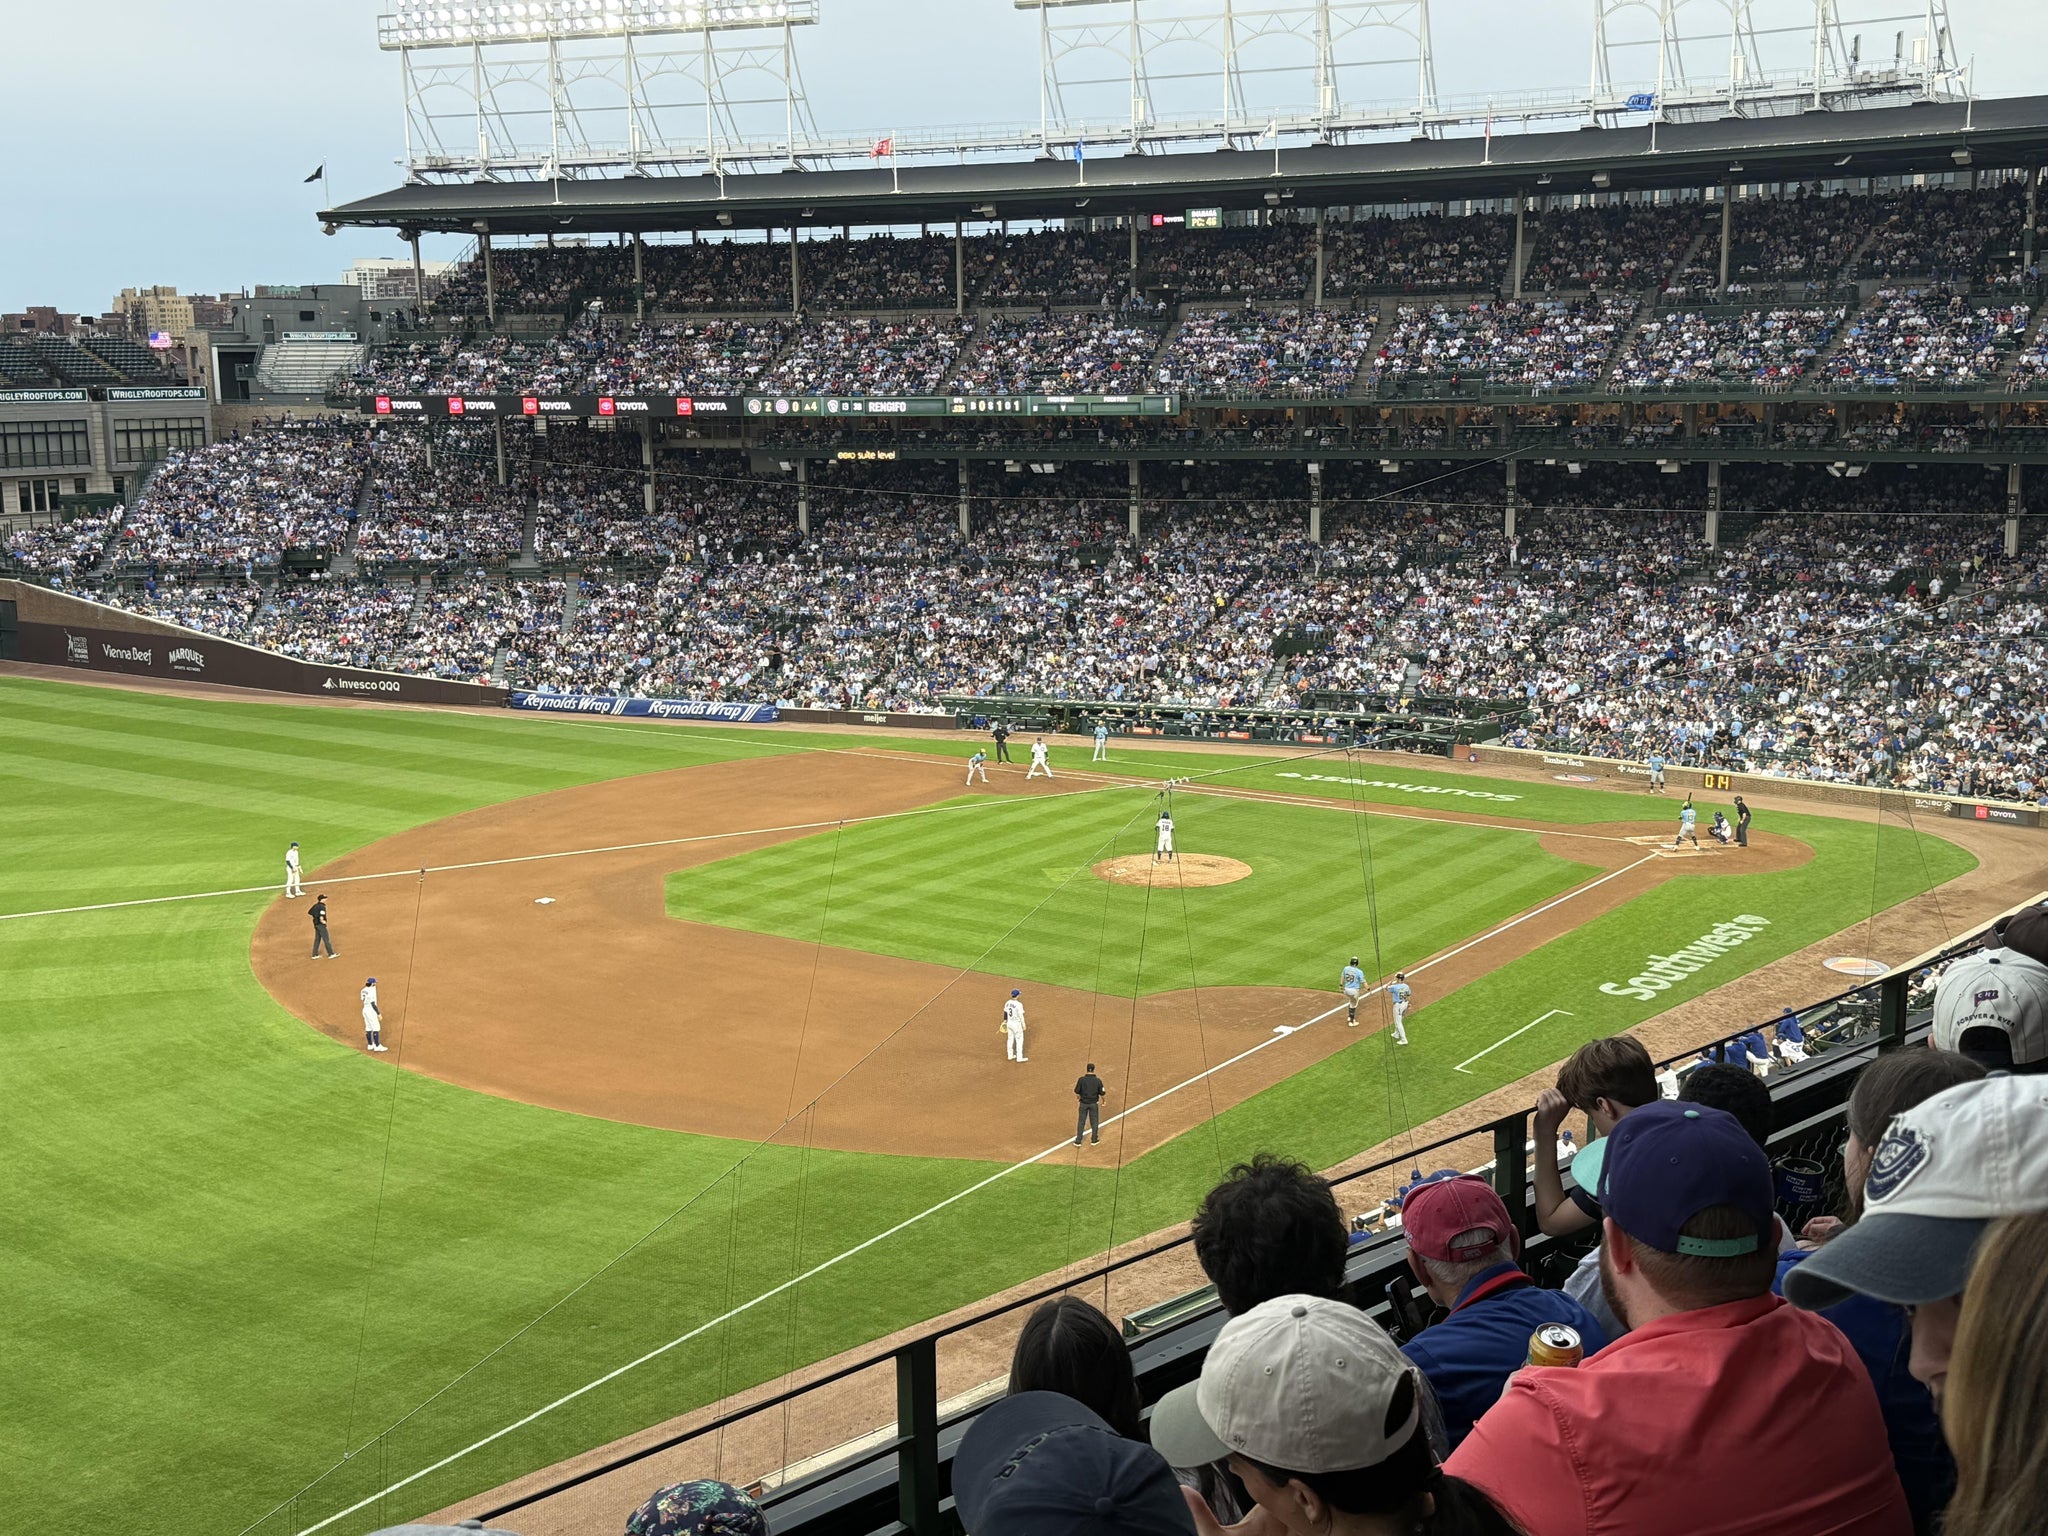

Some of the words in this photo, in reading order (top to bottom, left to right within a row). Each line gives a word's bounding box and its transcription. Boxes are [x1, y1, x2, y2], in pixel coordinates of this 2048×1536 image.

[0, 391, 83, 401] RIGLEYROOFTOPS.COM
[111, 389, 201, 399] WRIGLEYROOFTOPS.COM
[391, 401, 422, 409] TOYOTA
[464, 401, 496, 410] TOYOTA
[538, 401, 571, 410] TOYOTA
[615, 402, 648, 411] TOYOTA
[693, 402, 727, 411] TOYOTA
[765, 402, 772, 412] 2
[792, 402, 799, 412] 0
[810, 402, 818, 411] 4
[868, 401, 907, 412] RENGIFO
[858, 450, 876, 459] suite
[877, 450, 896, 459] level
[102, 643, 131, 660] Vienna
[132, 647, 152, 665] Beef
[168, 648, 205, 667] MARQUEE
[339, 678, 377, 690] Invesco
[378, 680, 400, 692] QQQ
[523, 693, 578, 711] Reynolds
[578, 697, 610, 713] Wrap
[649, 700, 706, 718] Reynolds
[706, 703, 742, 720] Wrap
[863, 714, 887, 724] meijer
[1542, 755, 1584, 767] TimberTech
[1626, 766, 1651, 775] Advoca
[1301, 773, 1525, 802] Southwest
[1989, 810, 2017, 819] TOYOTA
[1598, 922, 1764, 1002] Southwest
[1957, 1013, 1988, 1027] FOREVER
[1997, 1015, 2016, 1028] EVER
